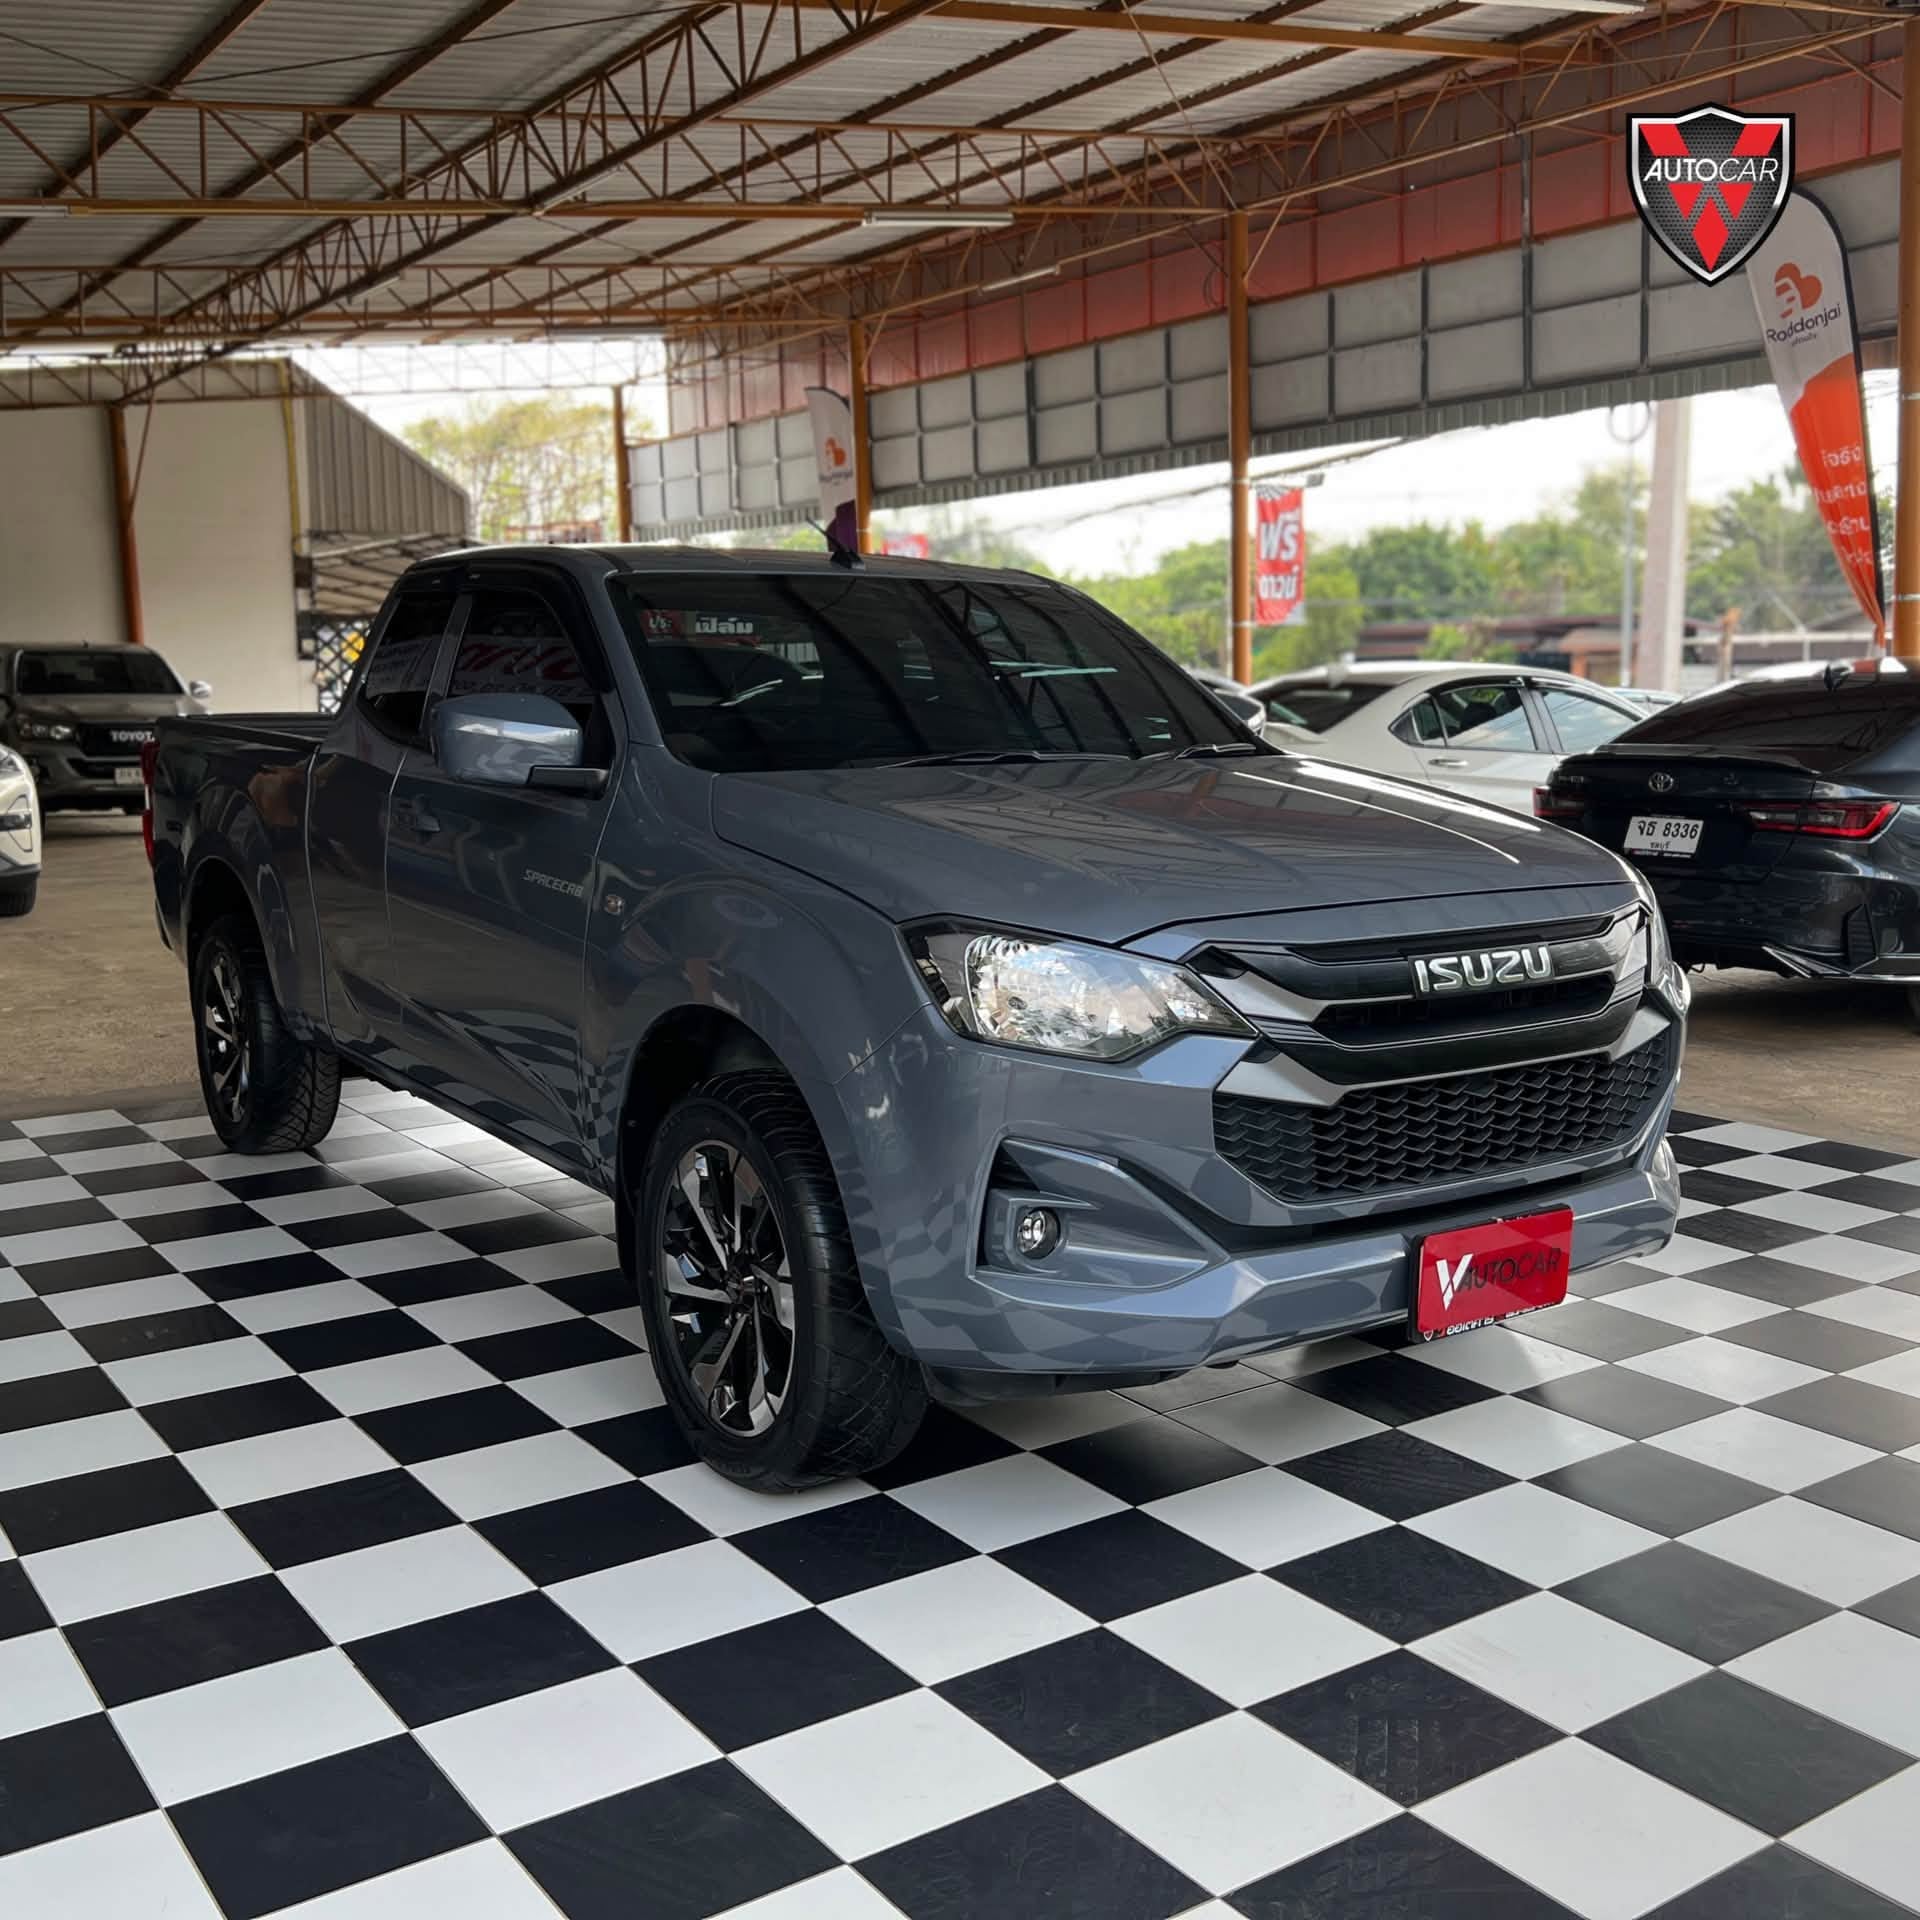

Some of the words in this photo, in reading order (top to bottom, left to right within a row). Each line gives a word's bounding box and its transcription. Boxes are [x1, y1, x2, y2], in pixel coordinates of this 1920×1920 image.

[1766, 303, 1841, 343] Roddonjai
[110, 730, 155, 742] TOYOT
[1662, 822, 1699, 840] 8336
[523, 869, 585, 897] SPACECAB
[1414, 946, 1552, 993] ISUZU
